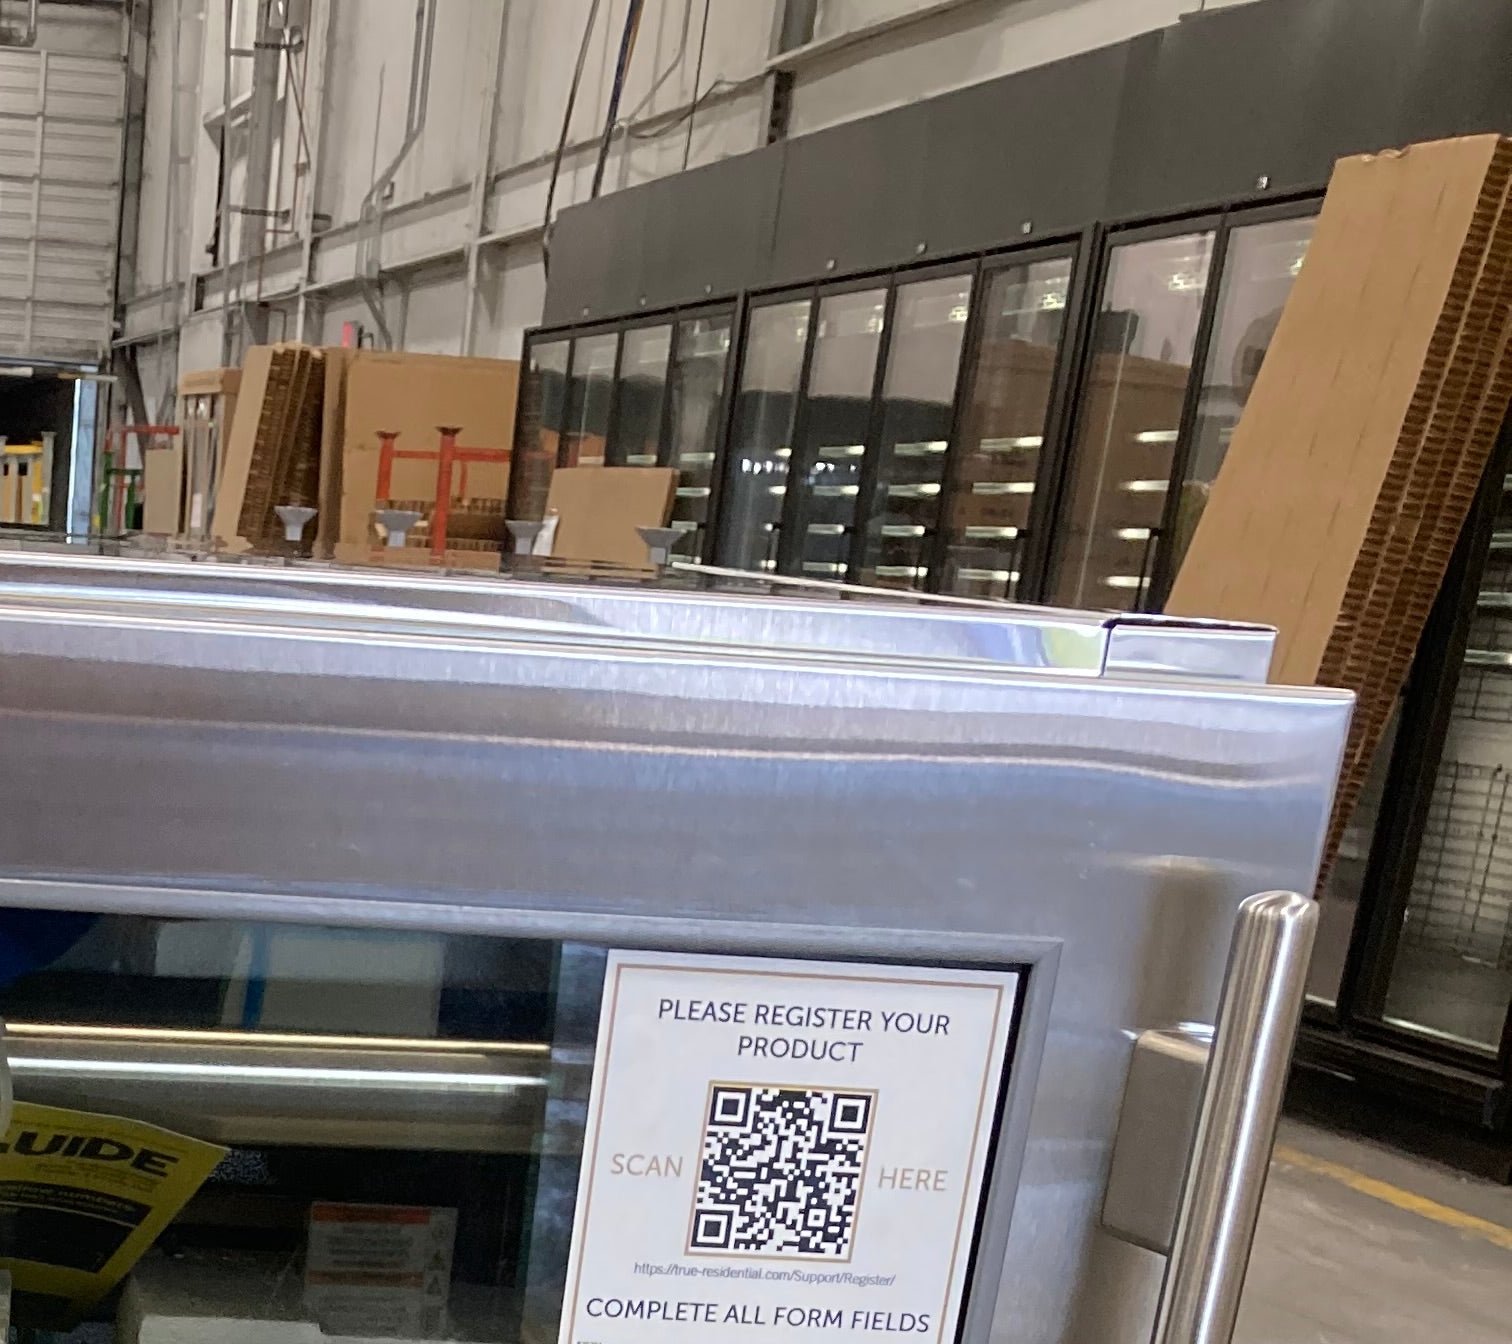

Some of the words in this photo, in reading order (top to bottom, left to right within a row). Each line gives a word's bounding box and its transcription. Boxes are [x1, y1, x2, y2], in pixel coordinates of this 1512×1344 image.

[658, 998, 748, 1025] PLEASE
[753, 1004, 873, 1033] REGISTER
[880, 1011, 951, 1036] YOUR
[737, 1036, 864, 1064] PRODUCT
[610, 1153, 684, 1178] SCAN
[878, 1167, 949, 1191] HERE
[633, 1262, 897, 1288] https://true-residential.com/Support/Register/
[586, 1297, 718, 1325] COMPLETE
[723, 1304, 766, 1325] ALL
[774, 1307, 843, 1329] FORM
[851, 1311, 931, 1334] FIELDS
